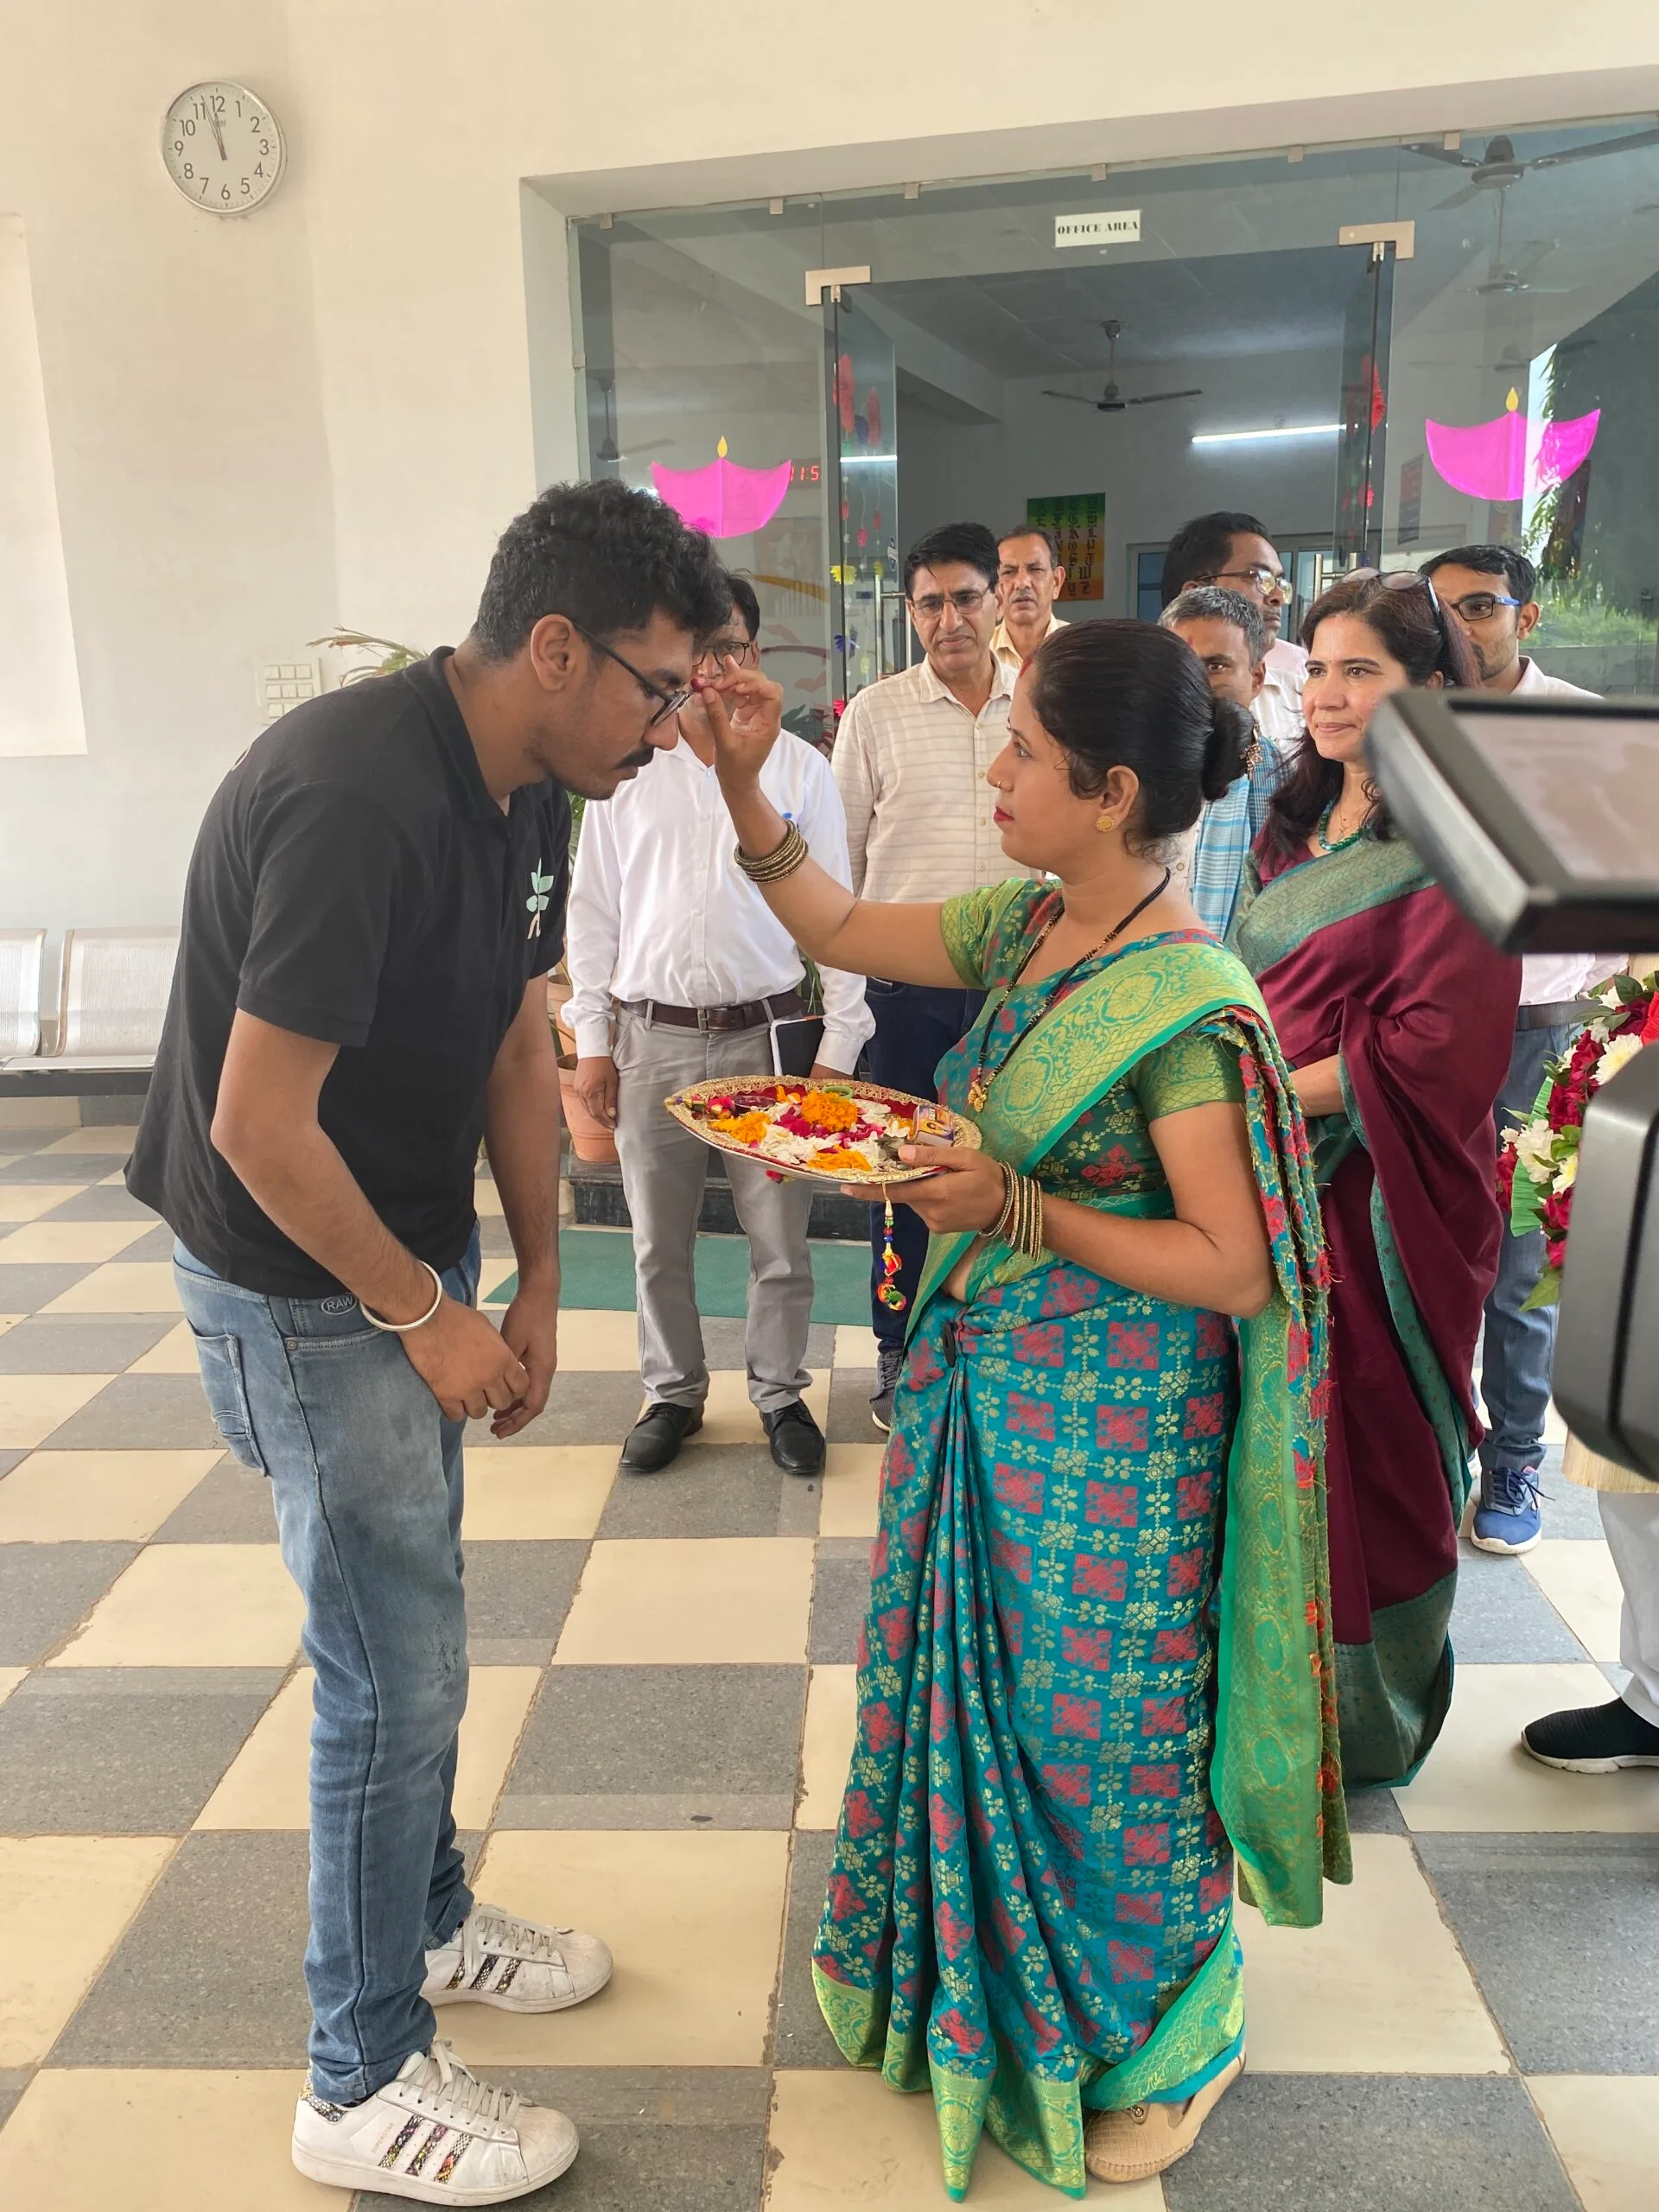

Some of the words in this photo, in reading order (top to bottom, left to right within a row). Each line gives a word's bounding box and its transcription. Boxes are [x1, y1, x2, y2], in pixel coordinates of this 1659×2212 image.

[193, 102, 207, 120] 11
[210, 95, 226, 112] 12
[235, 100, 242, 118] 1
[180, 119, 195, 137] 10
[250, 116, 261, 133] 2
[174, 140, 184, 157] 9
[259, 138, 270, 156] 3
[183, 162, 194, 180] 8
[253, 161, 264, 178] 4
[200, 177, 209, 194] 7
[220, 183, 231, 200] 6
[240, 177, 251, 194] 5
[1058, 224, 1101, 235] OFFICE
[1104, 221, 1138, 232] AREA
[327, 1295, 353, 1311] RAW
